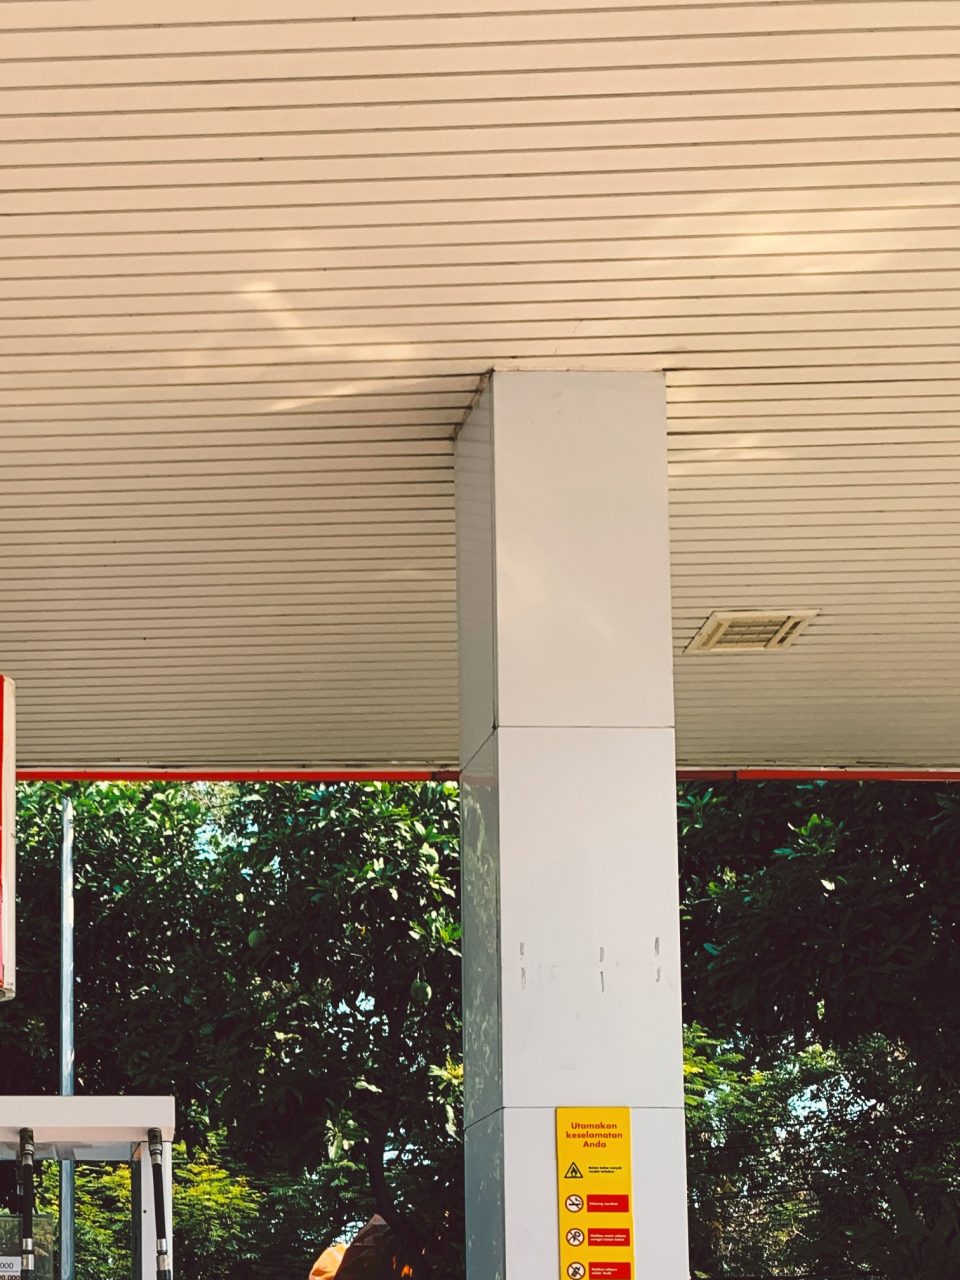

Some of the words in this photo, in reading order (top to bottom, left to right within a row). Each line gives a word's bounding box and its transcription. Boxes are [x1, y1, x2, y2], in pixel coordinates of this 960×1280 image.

[571, 1121, 617, 1129] Utamakan
[566, 1130, 623, 1139] keselamatan
[583, 1140, 607, 1148] Anda
